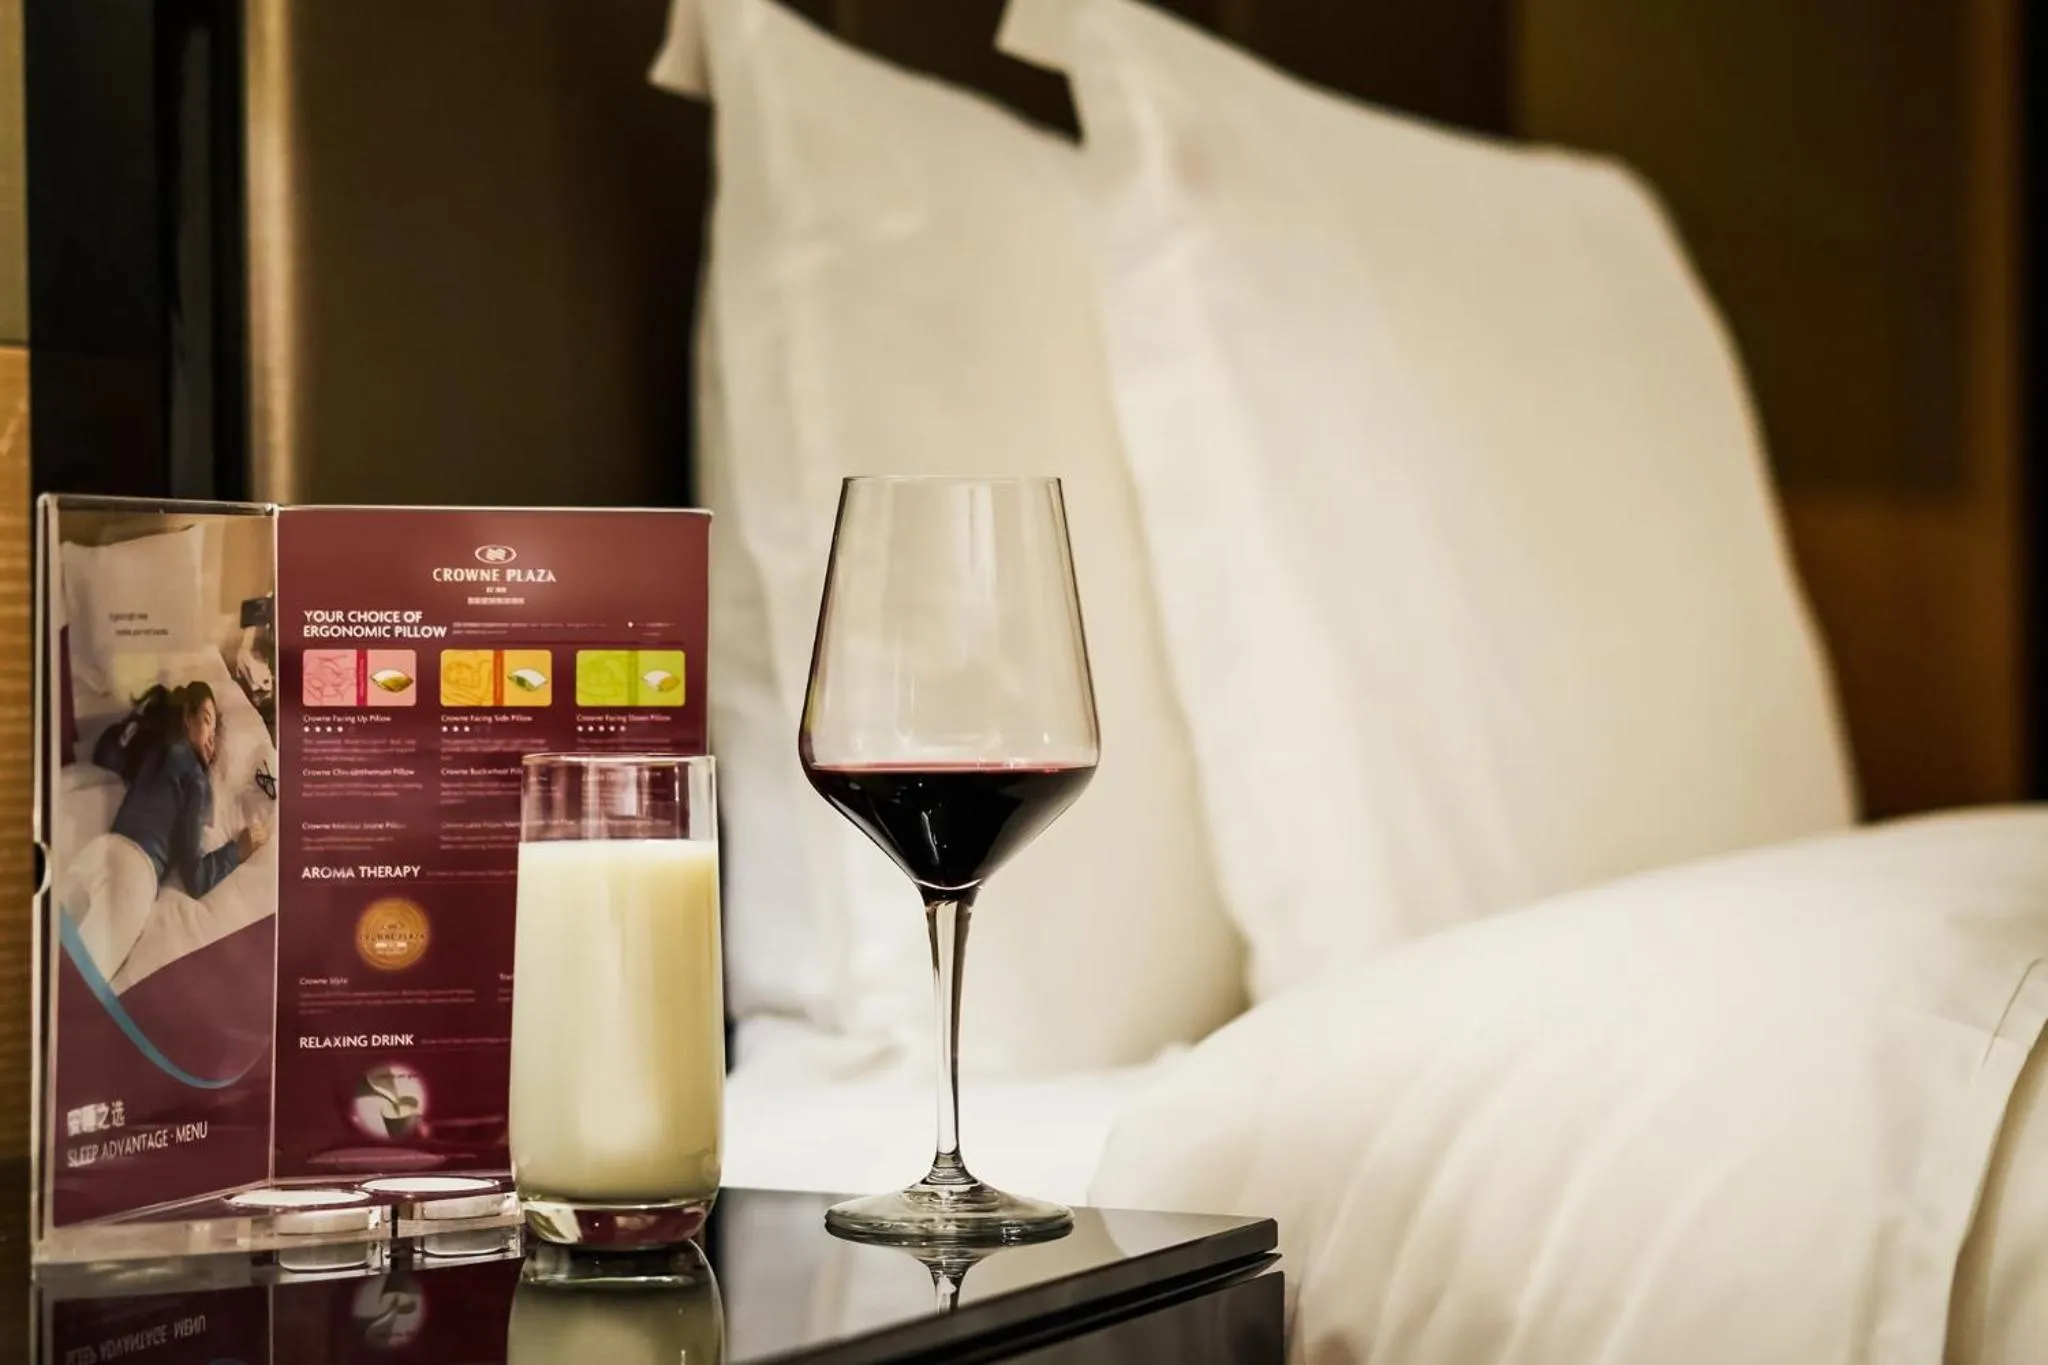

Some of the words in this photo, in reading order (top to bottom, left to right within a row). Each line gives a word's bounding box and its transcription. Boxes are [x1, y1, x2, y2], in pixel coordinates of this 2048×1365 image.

[432, 567, 501, 582] CROWNE
[505, 568, 557, 582] PLAZA
[303, 610, 345, 623] YOUR
[347, 610, 401, 623] CHOICE
[403, 610, 423, 623] OF
[303, 625, 391, 638] ERGONOMIC
[394, 625, 448, 638] PILLOW
[301, 866, 355, 879] AROMA
[358, 866, 421, 878] THERAPY
[299, 1035, 368, 1049] RELAXING
[371, 1034, 414, 1047] DRINK
[67, 1144, 99, 1168] SLEEP
[101, 1129, 169, 1160] ADVANTAGE
[175, 1120, 208, 1144] MENU
